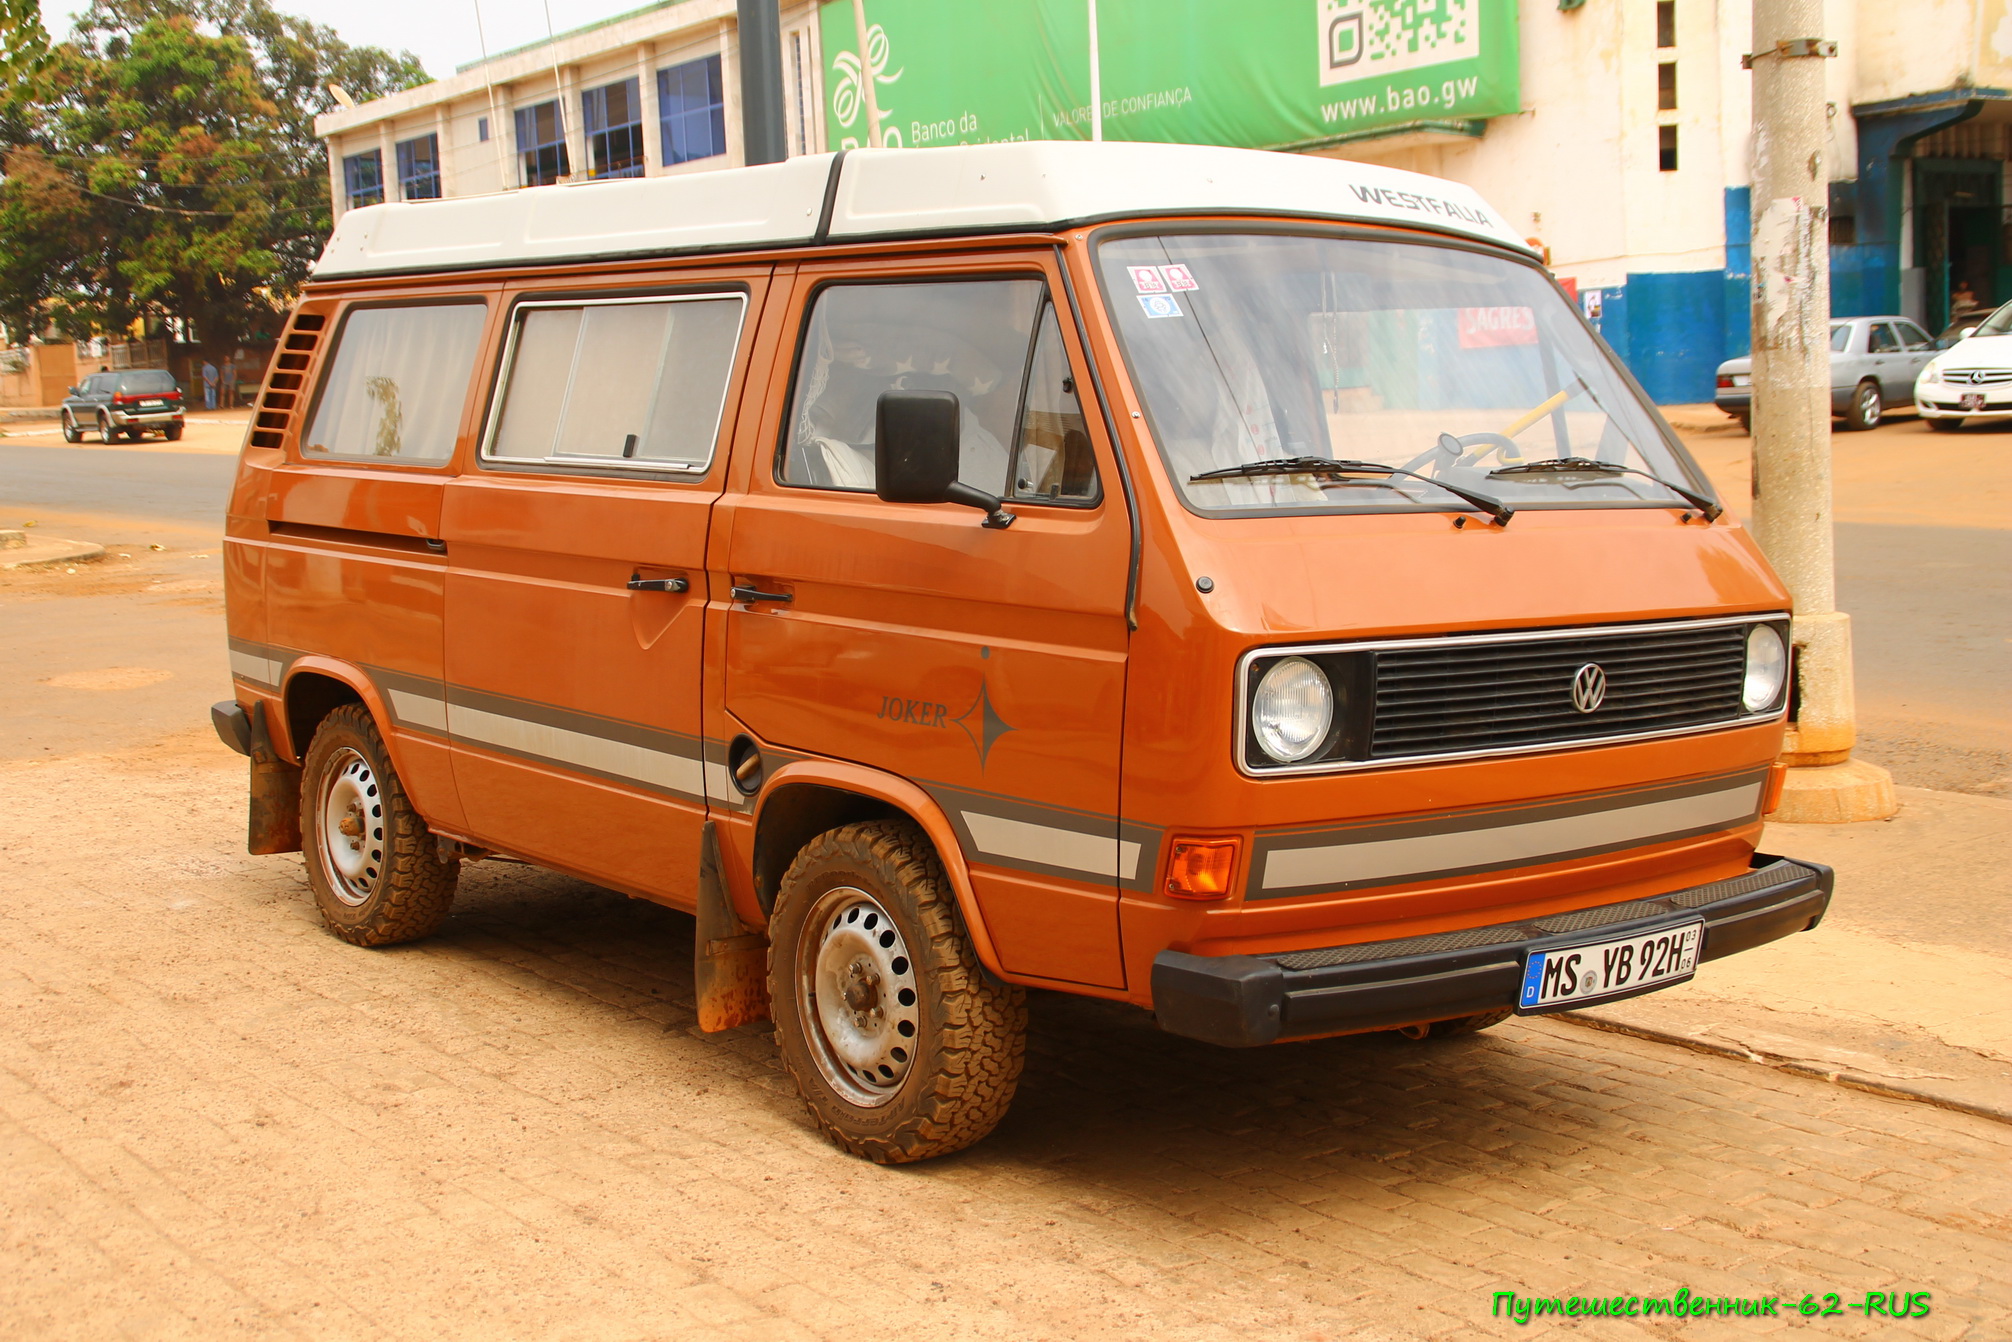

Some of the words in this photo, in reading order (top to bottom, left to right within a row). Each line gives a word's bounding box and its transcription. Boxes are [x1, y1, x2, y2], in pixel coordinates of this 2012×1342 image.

[1053, 105, 1094, 128] VALORE
[1103, 100, 1119, 118] DE
[1121, 85, 1192, 114] CONFIANÇA
[1321, 76, 1478, 123] www.bao.gw
[911, 119, 956, 143] Banco
[959, 110, 977, 133] da
[1348, 184, 1494, 228] WESTFALIA
[1464, 306, 1535, 335] SAGRES
[876, 696, 948, 729] JOKER
[1686, 929, 1697, 942] 03
[1541, 953, 1582, 999] MS
[1603, 944, 1635, 988] YB
[1638, 932, 1686, 980] 92H
[1526, 986, 1535, 998] D
